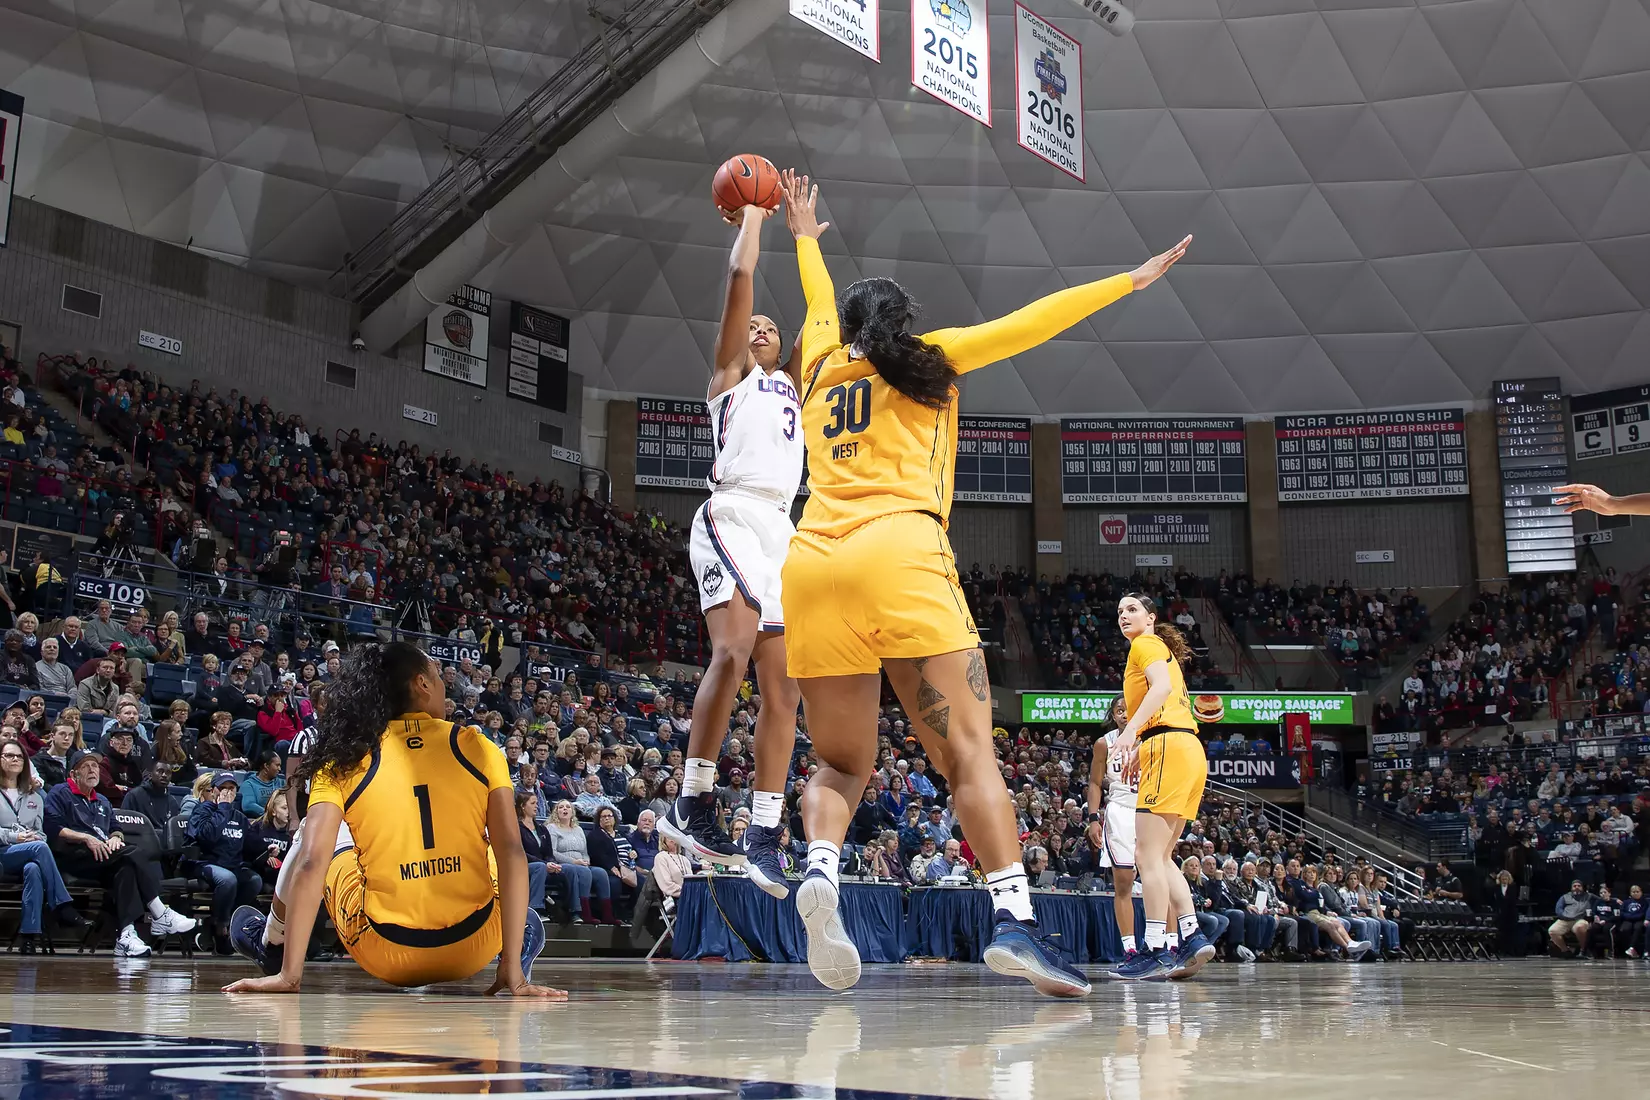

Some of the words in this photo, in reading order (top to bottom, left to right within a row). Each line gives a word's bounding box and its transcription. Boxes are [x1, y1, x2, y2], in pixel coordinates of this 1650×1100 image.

[812, 0, 864, 30] ATIONAL
[803, 4, 869, 50] CHAMPIONS
[1021, 9, 1045, 30] UConn
[1045, 25, 1075, 51] Women's
[1032, 28, 1066, 57] Basketball
[923, 27, 978, 79] 2015
[926, 60, 977, 97] NATIONAL
[922, 75, 982, 116] CHAMPIONS
[1027, 90, 1075, 139] 2016
[1030, 121, 1073, 155] NATIONAL
[1026, 135, 1077, 172] CHAMPIONS
[140, 334, 155, 344] SEC
[159, 337, 181, 352] 210
[758, 379, 799, 405] UCO
[641, 401, 666, 411] BIG
[823, 377, 872, 439] 30
[404, 408, 416, 417] SEC
[422, 411, 437, 423] 211
[641, 412, 693, 423] REGULAR
[1286, 417, 1327, 428] NCAA
[1335, 411, 1452, 426] CHAMPIONSHIP
[641, 423, 660, 436] 1990
[667, 425, 686, 438] 1994
[693, 426, 712, 440] 1995
[783, 407, 796, 442] 3
[978, 420, 1026, 429] CONFERENCE
[1069, 421, 1114, 429] NATIONAL
[1118, 421, 1169, 429] INVITATION
[1172, 421, 1235, 429] TOURNAMENT
[1285, 427, 1363, 437] TOURNAMENT
[1369, 423, 1455, 434] APPEARANCES
[1111, 431, 1194, 440] APPEARANCES
[1584, 431, 1601, 449] C
[1628, 424, 1640, 442] 9
[639, 442, 660, 455] 2003
[666, 443, 687, 456] 2005
[692, 445, 712, 458] 2006
[957, 440, 977, 453] 2002
[982, 441, 1002, 454] 2004
[1008, 442, 1027, 454] 2011
[1065, 443, 1084, 455] 1955
[1092, 443, 1110, 455] 1974
[1118, 443, 1136, 455] 1975
[1144, 442, 1163, 454] 1980
[1170, 442, 1188, 454] 1981
[1196, 442, 1215, 454] 1982
[1222, 442, 1241, 454] 1988
[1281, 440, 1299, 453] 1951
[1307, 439, 1326, 452] 1954
[1333, 438, 1353, 451] 1956
[1360, 437, 1379, 449] 1957
[1387, 435, 1407, 448] 1958
[1414, 434, 1434, 447] 1959
[1441, 433, 1461, 446] 1960
[552, 448, 563, 457] SEC
[566, 451, 581, 463] 212
[831, 441, 859, 461] WEST
[1065, 461, 1085, 473] 1989
[1092, 460, 1111, 473] 1993
[1118, 460, 1137, 472] 1997
[1144, 460, 1163, 472] 2001
[1170, 460, 1190, 472] 2010
[1196, 460, 1216, 472] 2015
[1281, 458, 1301, 471] 1963
[1308, 457, 1327, 470] 1964
[1334, 456, 1354, 469] 1965
[1362, 455, 1380, 467] 1967
[1388, 453, 1408, 466] 1976
[1415, 453, 1435, 466] 1979
[1442, 452, 1463, 464] 1990
[641, 476, 708, 487] CONNECTICU
[1282, 476, 1301, 489] 1991
[1309, 475, 1328, 488] 1992
[1335, 474, 1355, 487] 1994
[1363, 473, 1382, 486] 1995
[1389, 472, 1409, 485] 1996
[1417, 471, 1437, 484] 1998
[1444, 470, 1464, 483] 1999
[963, 493, 1026, 502] BASKETBALL
[1068, 494, 1138, 502] CONNECTICUT
[1284, 490, 1355, 500] CONNECTICUT
[1360, 488, 1391, 497] MEN'S
[1396, 486, 1464, 496] BASKETBALL
[1153, 515, 1183, 524] 1988
[1105, 525, 1123, 535] NIT
[1128, 525, 1163, 533] NATIONAL
[1167, 524, 1209, 533] INVITATION
[1129, 534, 1172, 543] TOURNAMENT
[1175, 534, 1210, 543] CHAMPION
[1592, 531, 1612, 543] 213
[1161, 556, 1168, 564] 5
[1382, 551, 1390, 560] 6
[78, 580, 103, 594] SEC
[108, 583, 145, 605] 109
[430, 646, 449, 657] SEC
[452, 646, 481, 664] 109
[532, 665, 542, 675] SE
[554, 667, 565, 681] 11
[1035, 697, 1075, 708] GREAT
[1078, 697, 1112, 708] TAST
[1230, 699, 1282, 710] BEYOND
[1031, 709, 1074, 720] PLANT
[1081, 709, 1108, 720] BAS
[1253, 710, 1322, 721] SANH
[1390, 732, 1408, 742] 213
[1207, 760, 1276, 776] UCONN
[1393, 758, 1412, 769] 113
[1144, 794, 1158, 805] Cal
[412, 783, 436, 850] 1
[400, 855, 461, 881] MCINTOSH
